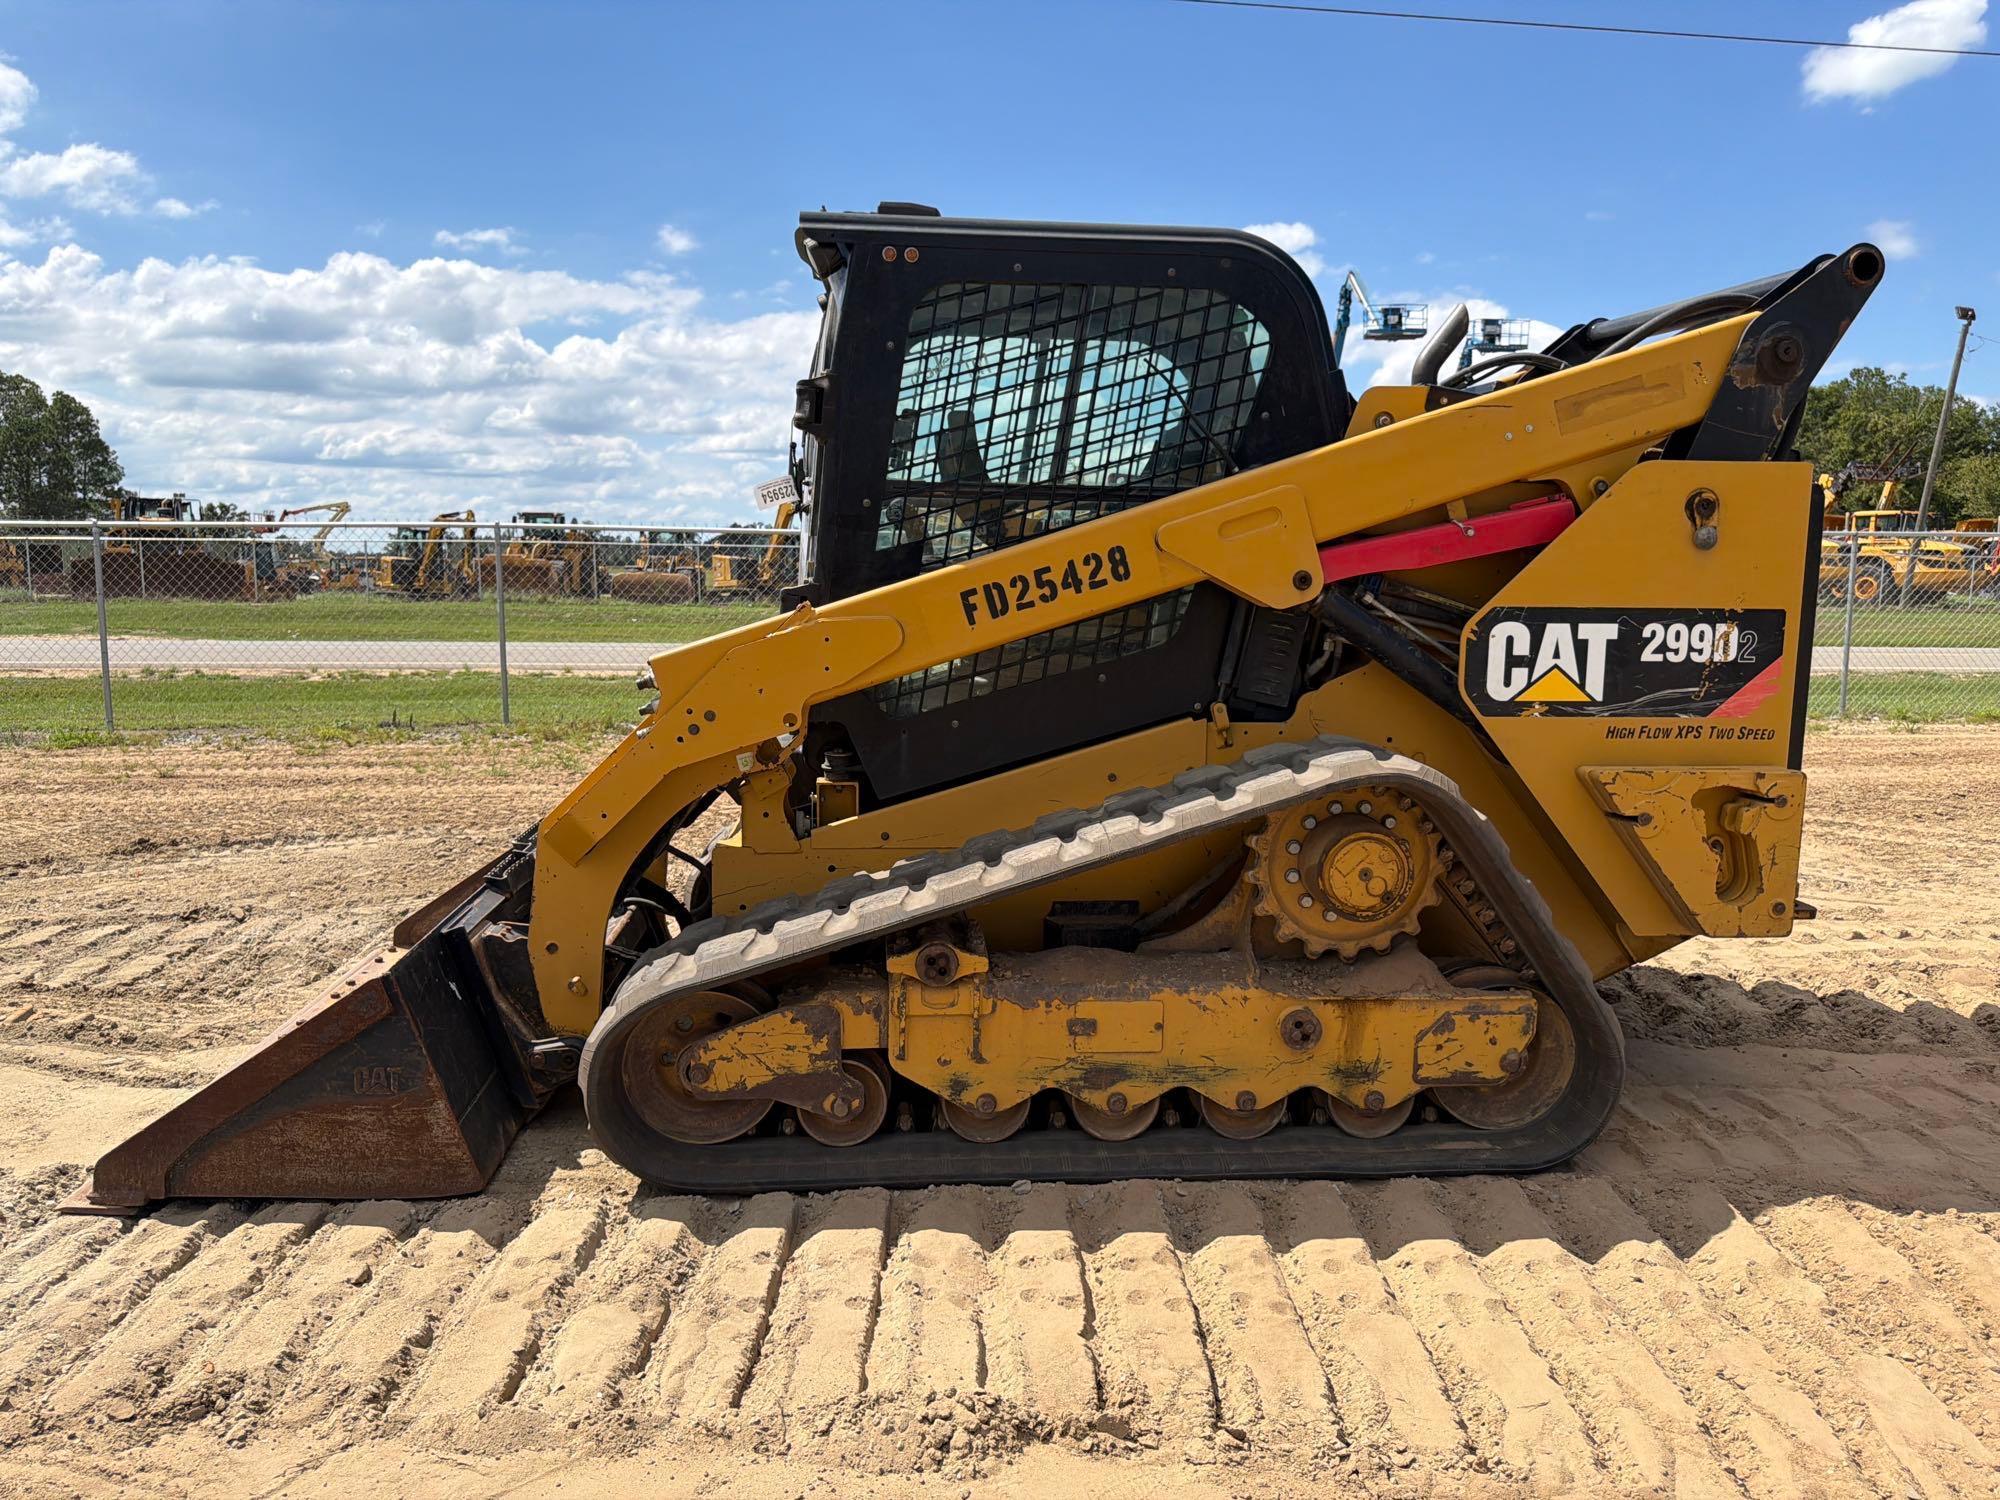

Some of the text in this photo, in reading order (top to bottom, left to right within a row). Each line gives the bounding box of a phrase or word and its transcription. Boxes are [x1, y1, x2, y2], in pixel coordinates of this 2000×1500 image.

[762, 485, 795, 504] 225954
[960, 545, 1131, 626] FD25428
[1486, 621, 1758, 702] CAT 299D2
[1606, 725, 1776, 740] HIGH FLOW XPS TWO SPEED
